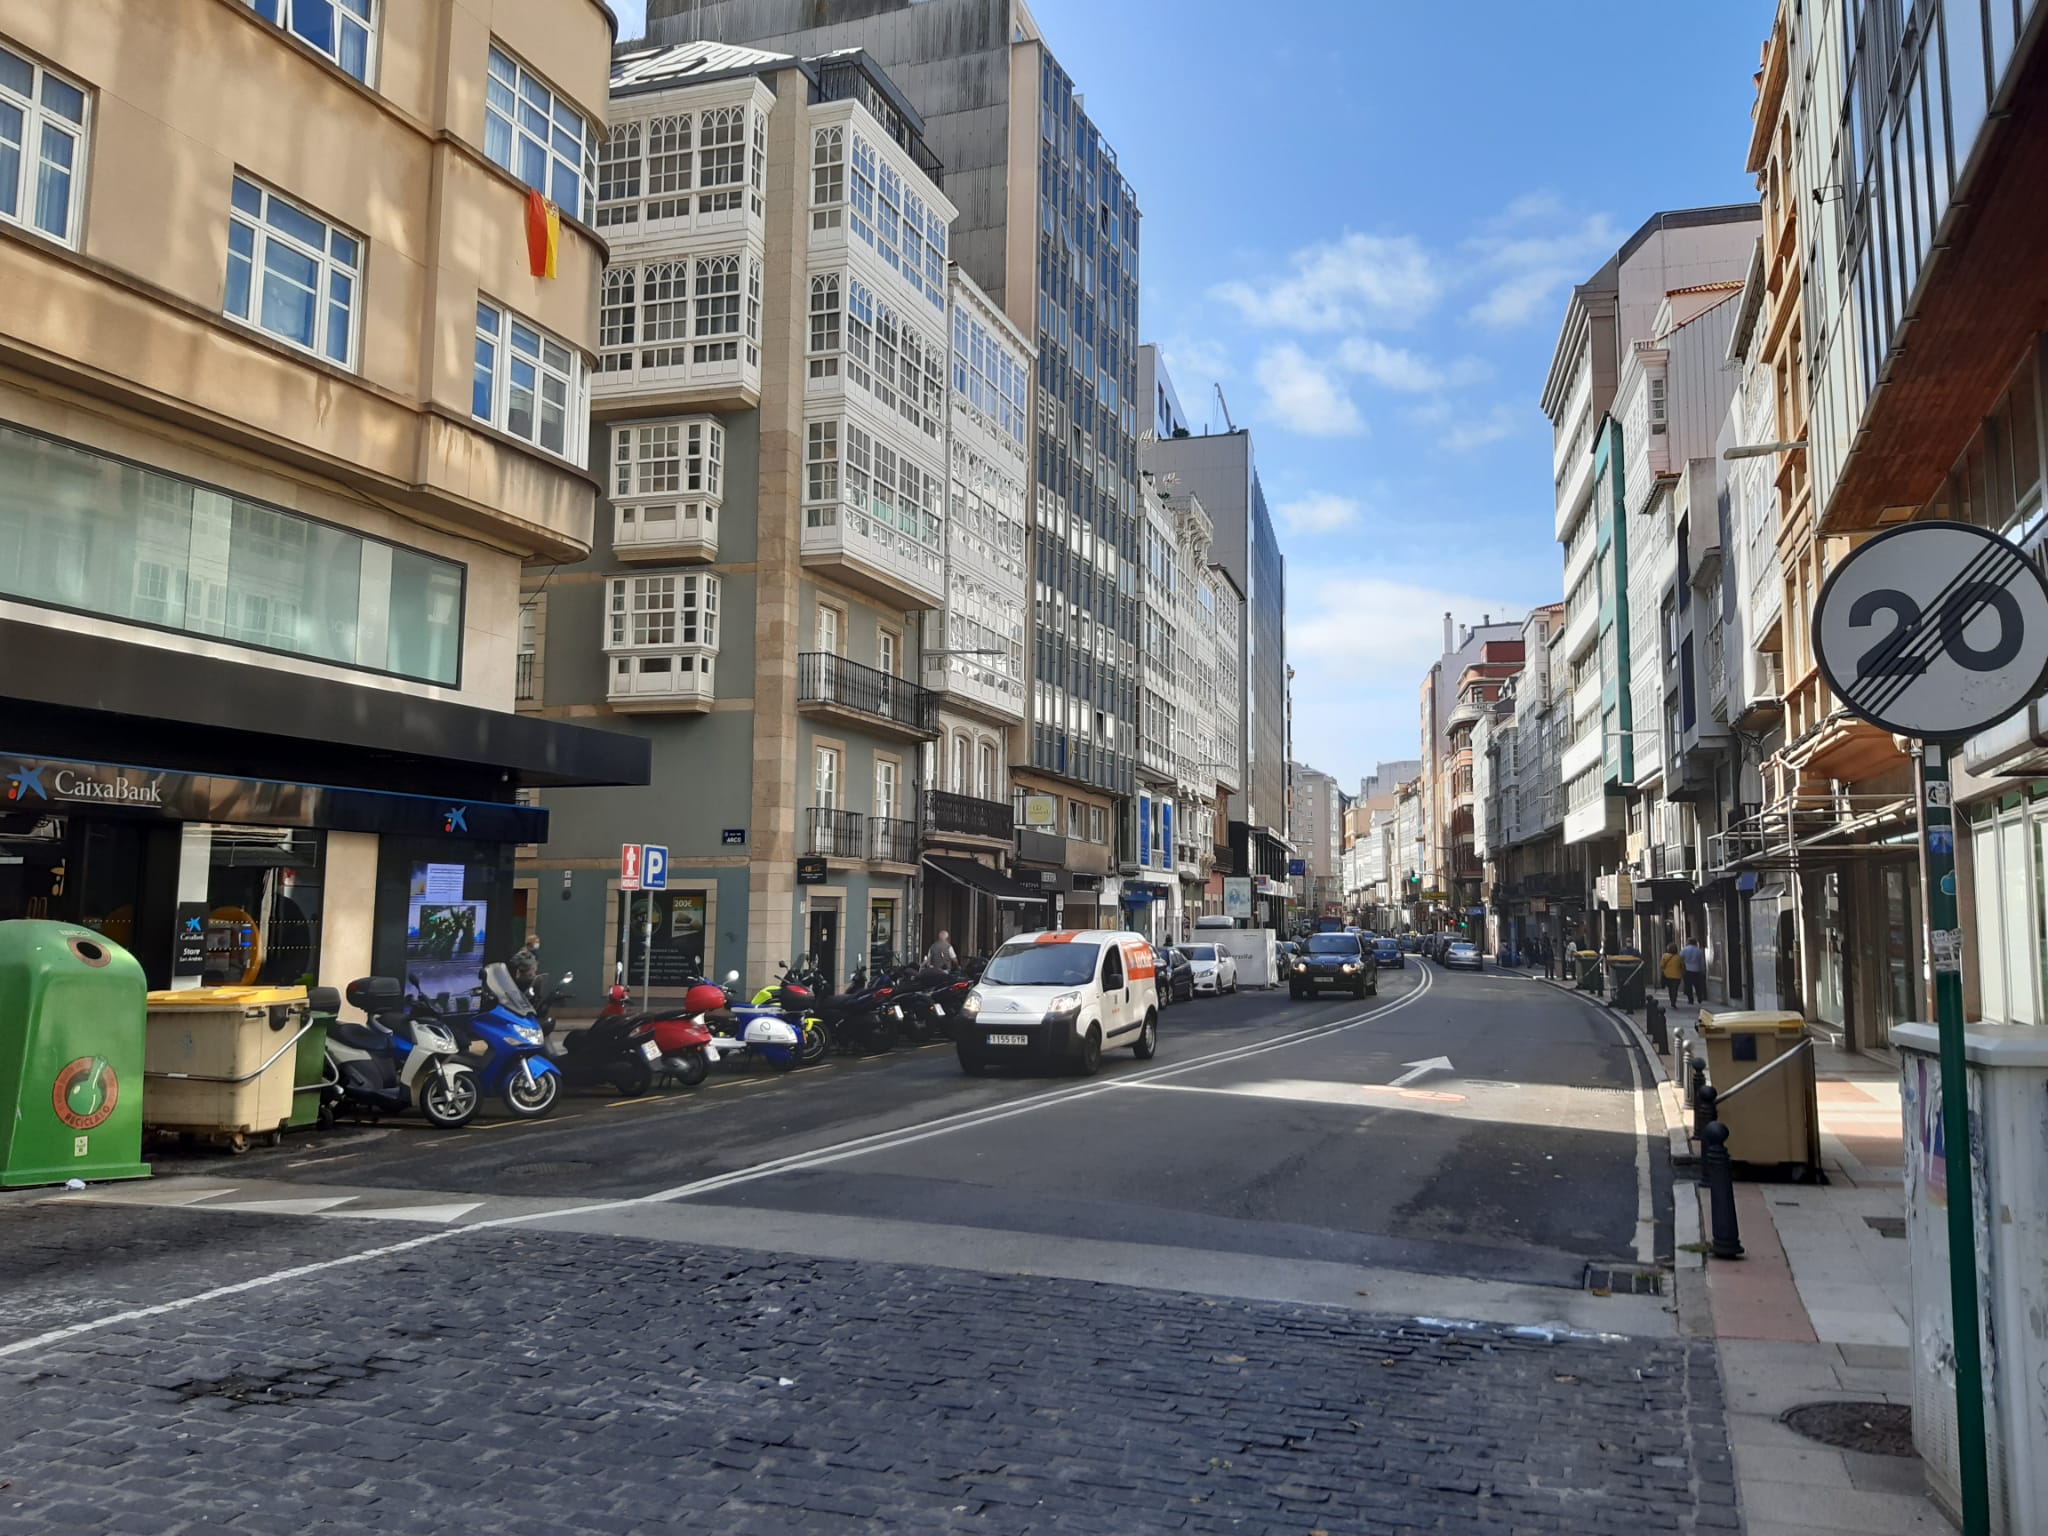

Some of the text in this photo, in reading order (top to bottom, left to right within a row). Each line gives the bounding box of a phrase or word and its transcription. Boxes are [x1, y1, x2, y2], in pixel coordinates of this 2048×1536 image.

[1849, 581, 2025, 678] 20
[54, 769, 162, 802] CaixaBank
[647, 850, 663, 884] P
[183, 947, 201, 956] Store
